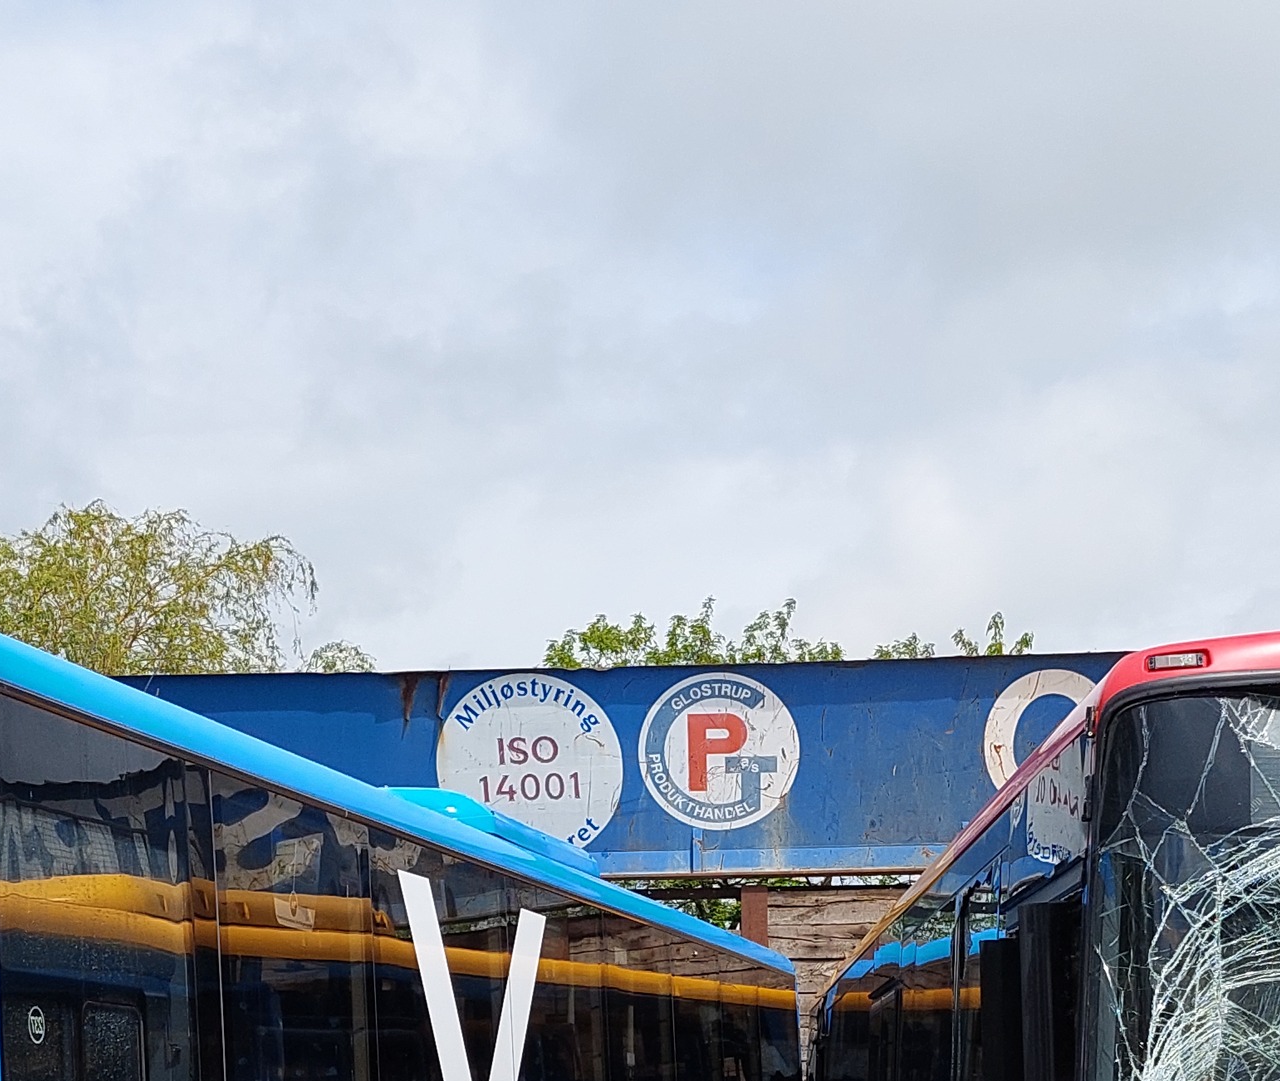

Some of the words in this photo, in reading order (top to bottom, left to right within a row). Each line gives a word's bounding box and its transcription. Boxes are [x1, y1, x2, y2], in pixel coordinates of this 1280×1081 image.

[455, 678, 601, 734] Miljøstyring
[670, 683, 752, 711] GLOSTRUP
[496, 735, 559, 766] ISO
[478, 771, 581, 803] 14001
[648, 753, 756, 820] PRODUKTHANDEL
